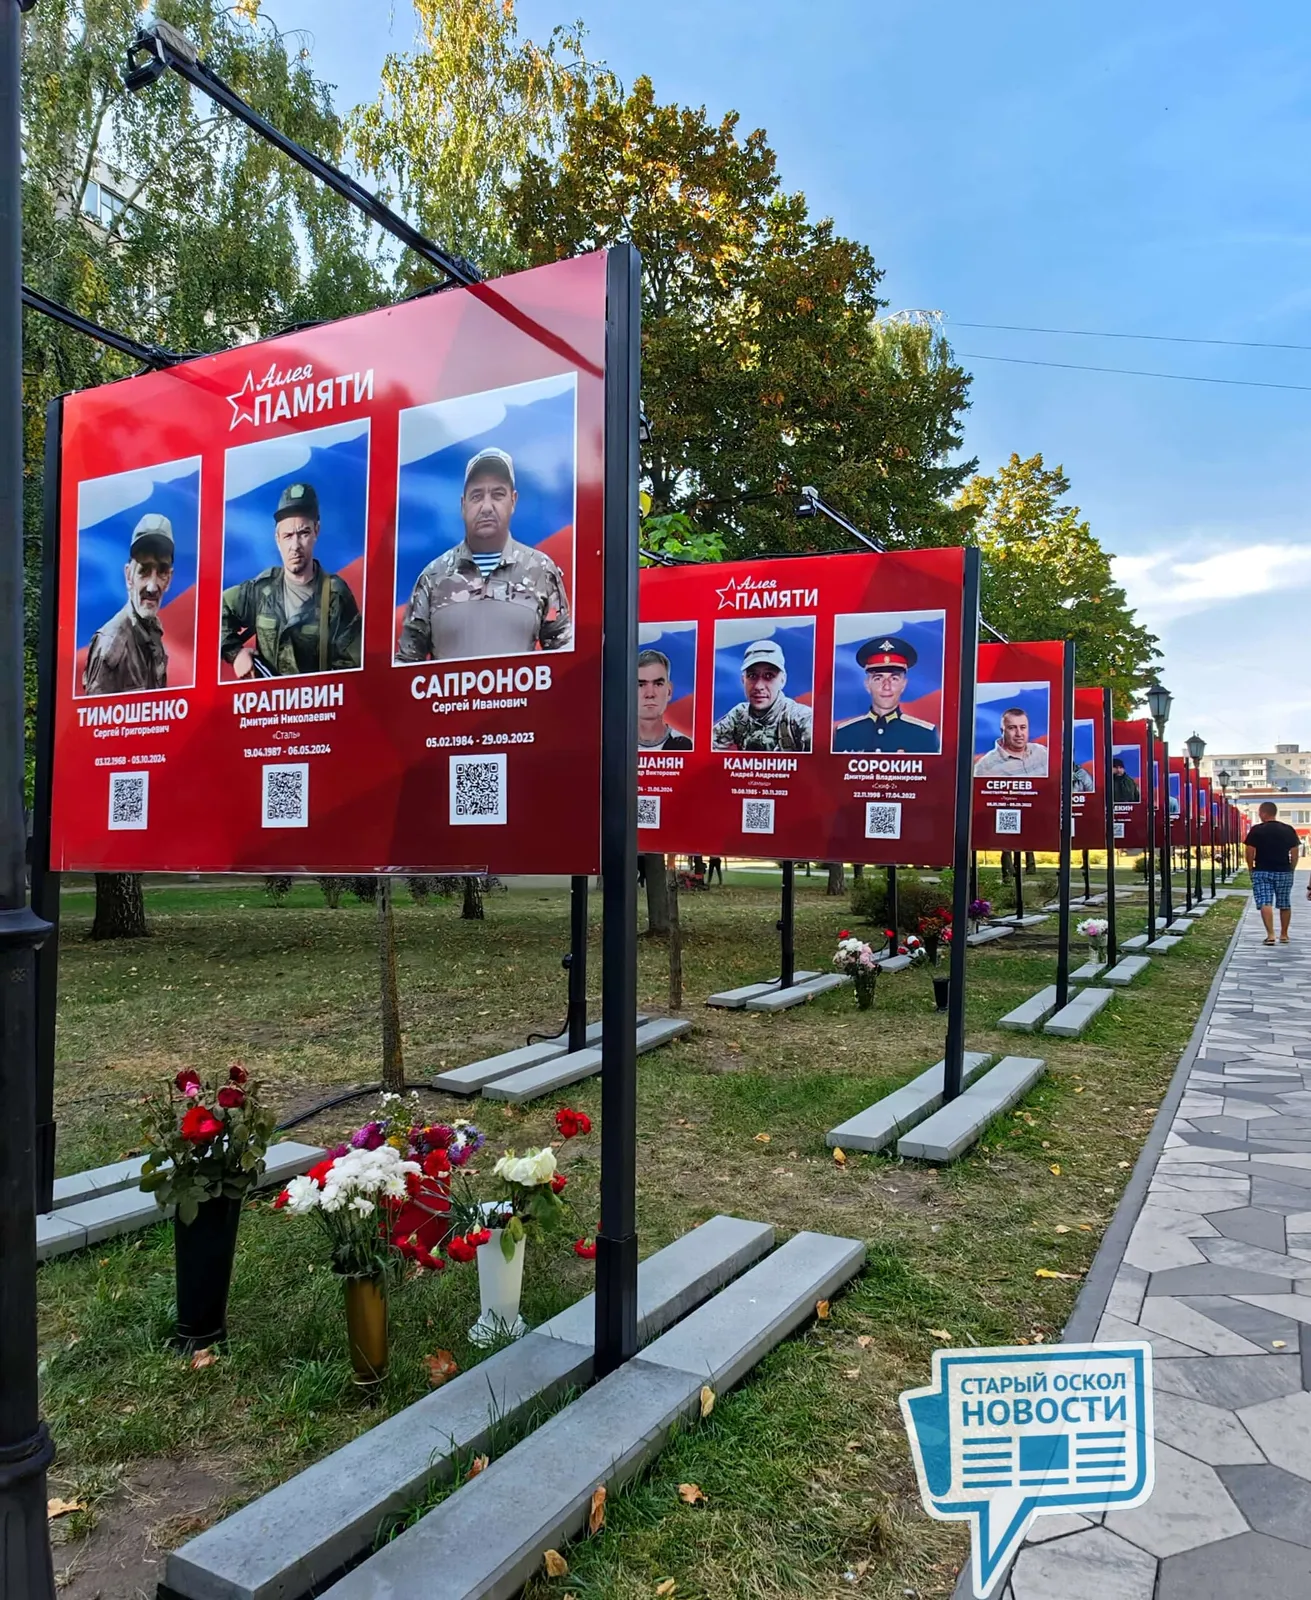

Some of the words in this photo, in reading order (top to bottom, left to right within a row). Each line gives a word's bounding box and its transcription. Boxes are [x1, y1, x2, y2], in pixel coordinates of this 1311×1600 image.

[256, 363, 314, 391] Аллея
[254, 368, 374, 426] ПАМЯТИ
[737, 575, 777, 590] Аллея
[735, 588, 818, 610] ПАМЯТИ
[411, 665, 552, 700] САПРОНОВ
[233, 683, 344, 714] КРАПИВИН
[432, 699, 469, 714] Сергей
[472, 698, 527, 710] Иванович
[77, 698, 188, 727] ТИМОШЕНКО
[240, 715, 279, 729] Дмитрий
[281, 712, 336, 725] Николаевич
[93, 727, 119, 739] Сергей
[121, 725, 169, 738] Григорьевич
[272, 730, 300, 740] «Сталь»
[426, 735, 474, 748] 05.02.1984
[482, 732, 534, 745] 29.09.2023
[244, 747, 281, 758] 19.04.1987
[288, 744, 331, 756] 06.05.2024
[132, 754, 166, 764] 05.10.2024
[724, 758, 797, 771] КАМЫНИН
[848, 759, 923, 773] СОРОКИН
[844, 773, 874, 781] Дмитрий
[876, 774, 926, 782] Владимирович
[986, 781, 1032, 790] СЕРГЕЕВ
